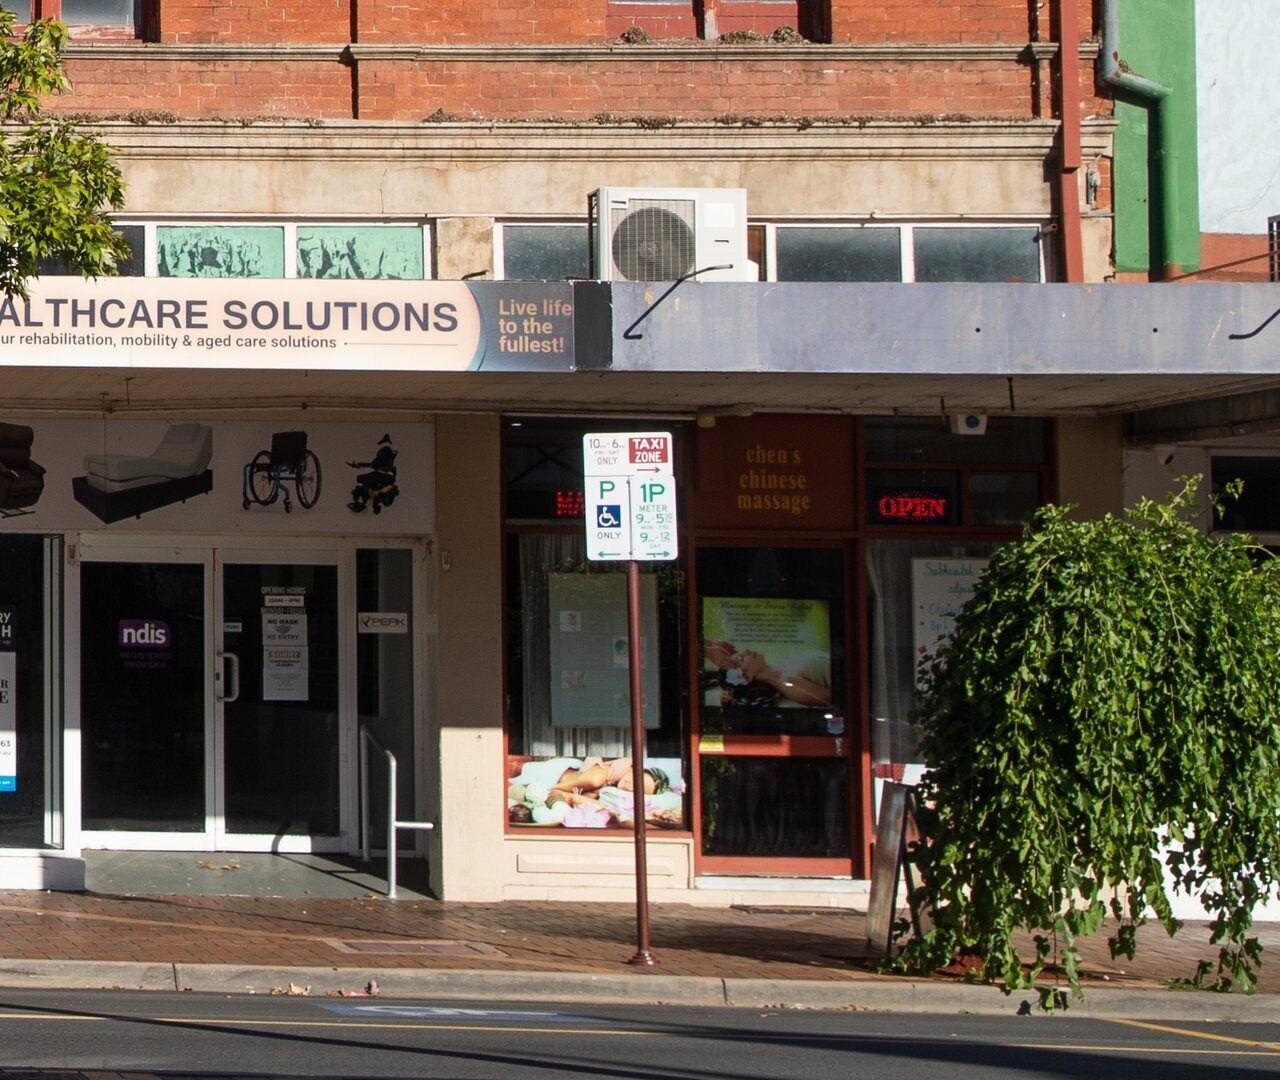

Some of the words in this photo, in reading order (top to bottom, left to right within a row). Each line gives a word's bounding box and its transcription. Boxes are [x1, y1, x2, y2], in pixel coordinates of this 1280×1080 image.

[223, 299, 459, 333] SOLUTIONS
[498, 299, 538, 317] Live
[542, 299, 574, 317] life
[498, 319, 518, 335] to
[522, 318, 553, 335] the
[19, 332, 117, 349] rehabilitation,
[121, 333, 178, 350] mobility
[182, 335, 192, 348] &
[197, 334, 232, 351] aged
[235, 338, 267, 349] care
[270, 335, 337, 349] solutions
[498, 335, 565, 354] fullest!
[632, 438, 665, 450] TAXI
[597, 457, 618, 465] ONLY
[634, 451, 663, 463] ZONE
[739, 469, 808, 490] chinese
[600, 480, 616, 500] P
[640, 483, 666, 503] 1P
[639, 505, 668, 513] METER
[736, 493, 811, 516] massage
[878, 496, 947, 519] OPEN
[597, 531, 622, 540] ONLY
[372, 617, 406, 626] PEAK
[122, 622, 167, 644] ndis
